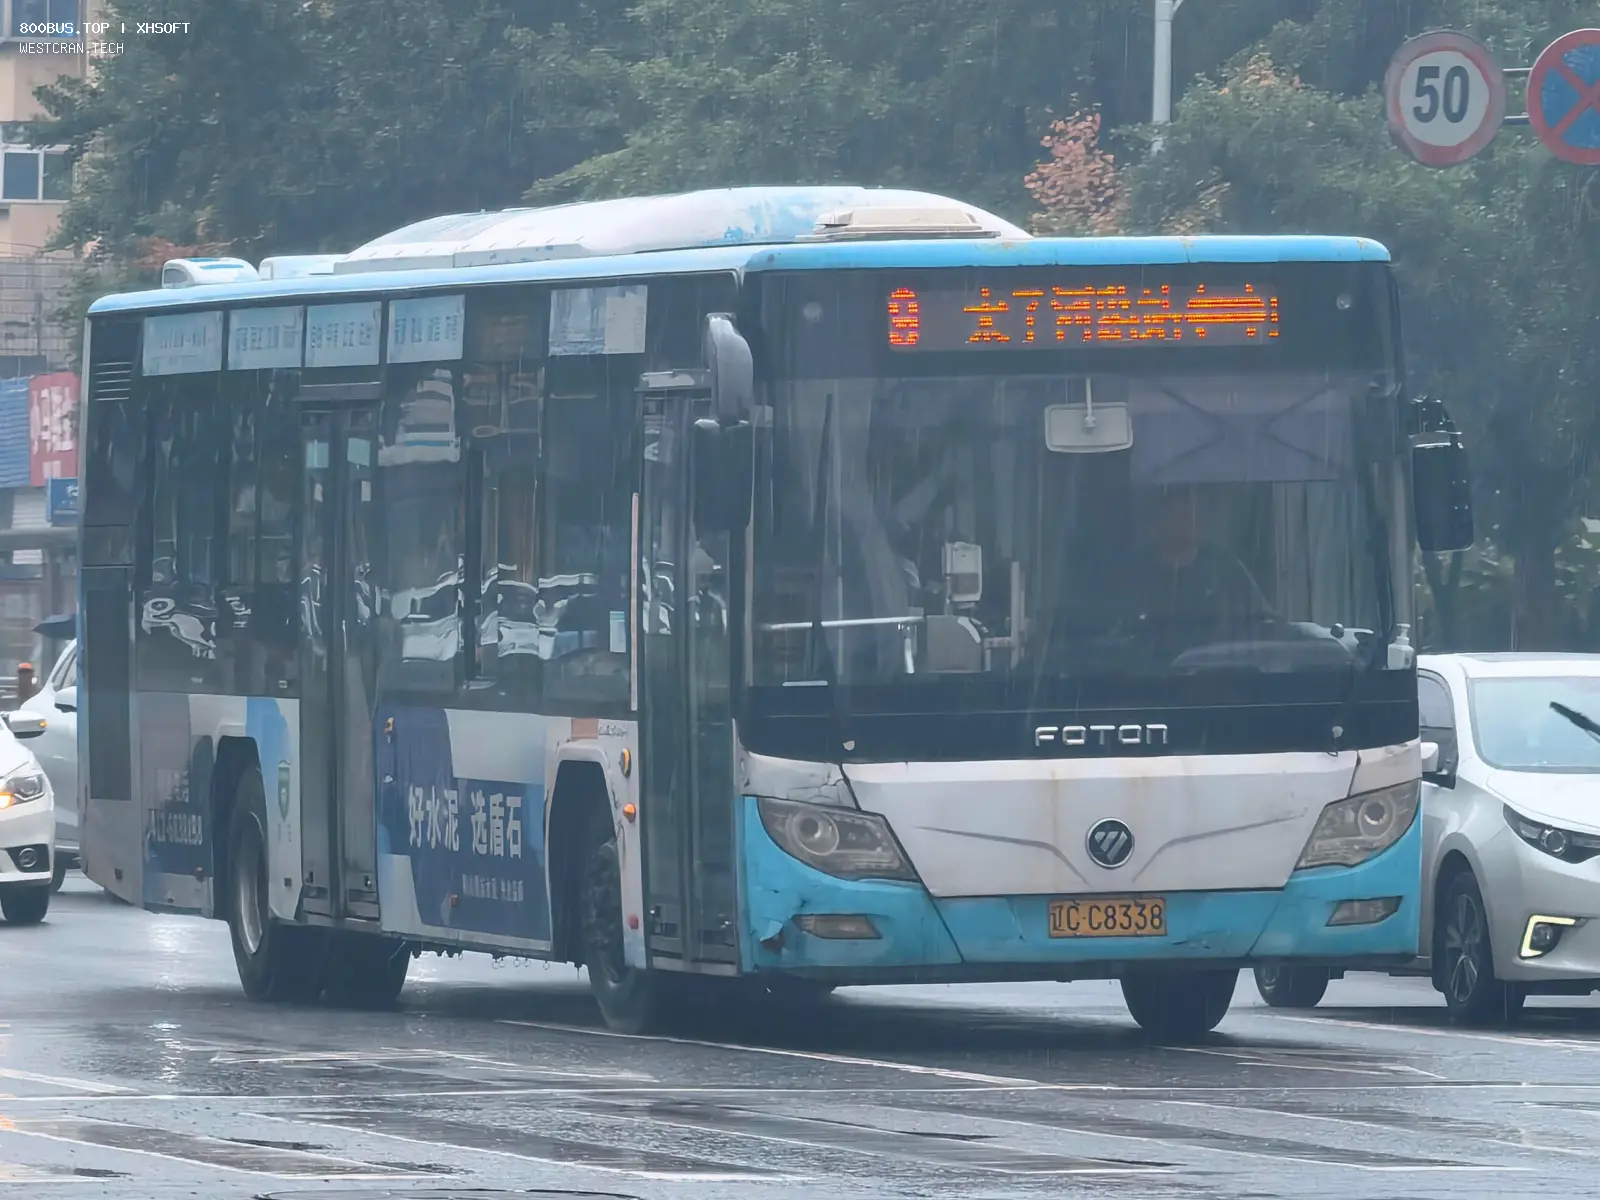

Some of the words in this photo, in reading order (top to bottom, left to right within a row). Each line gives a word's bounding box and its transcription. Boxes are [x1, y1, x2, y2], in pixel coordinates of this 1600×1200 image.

[1413, 65, 1470, 123] 50
[1034, 723, 1168, 747] FOTON
[408, 784, 460, 852] 好水泥
[470, 789, 522, 860] 选盾石
